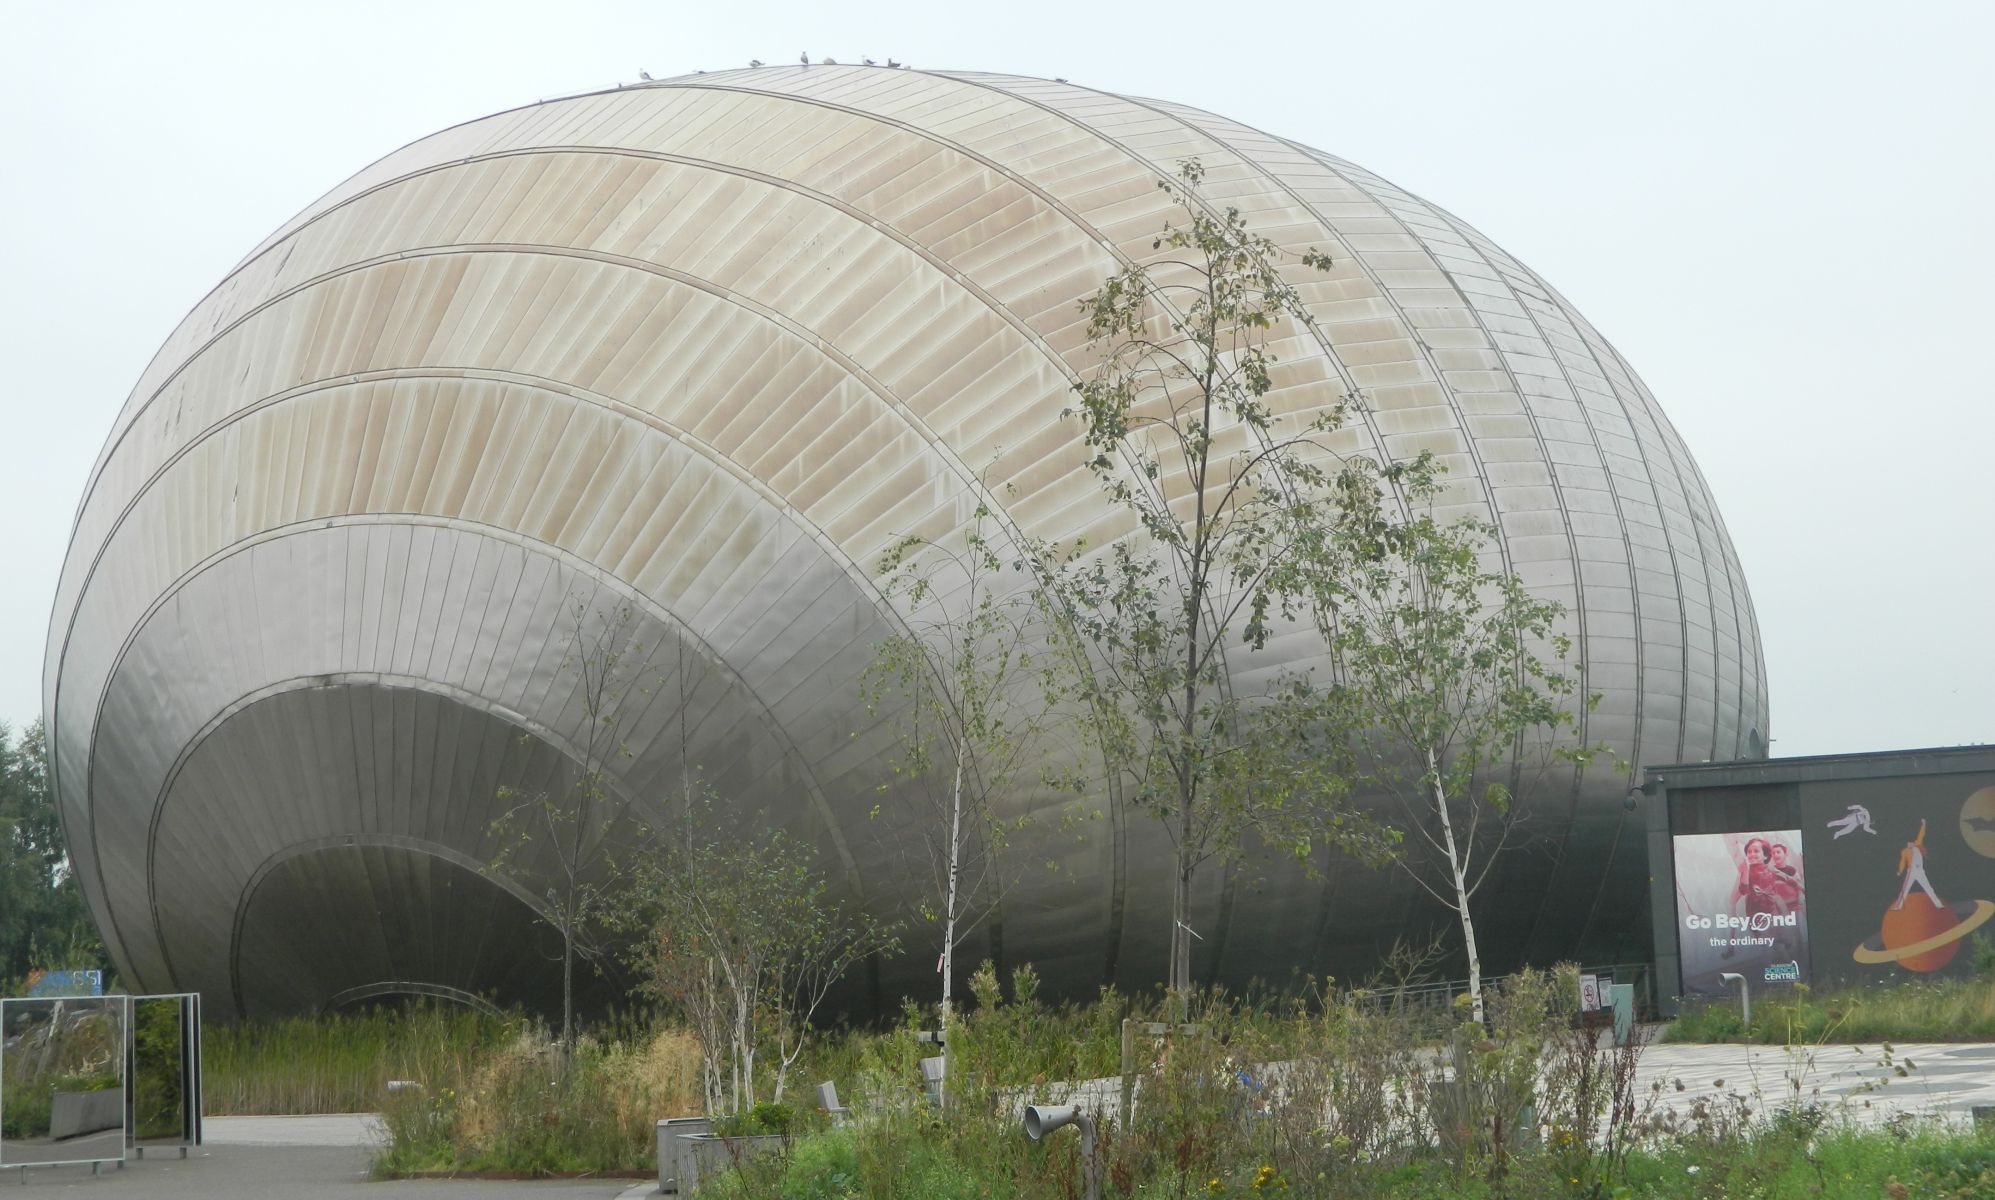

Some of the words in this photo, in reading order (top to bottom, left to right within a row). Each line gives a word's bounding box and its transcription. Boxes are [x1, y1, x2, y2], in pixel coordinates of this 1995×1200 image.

[1686, 914, 1712, 929] Go
[1710, 937, 1726, 946] the
[1729, 936, 1775, 947] ordinary
